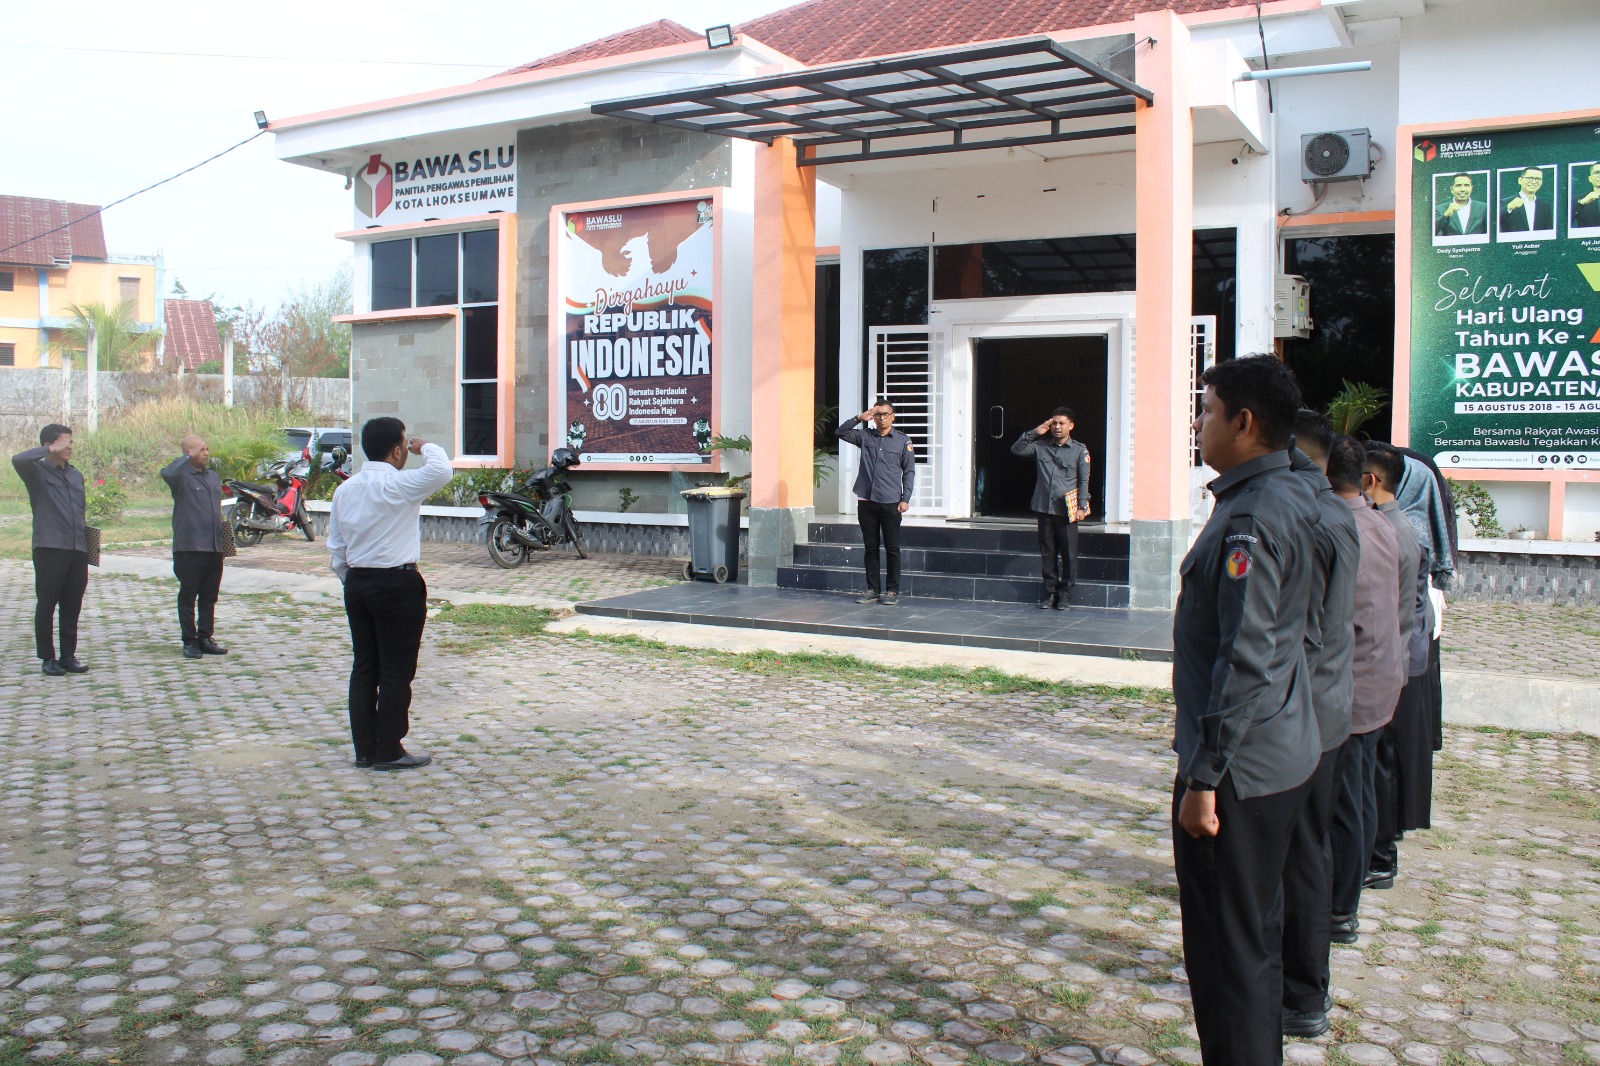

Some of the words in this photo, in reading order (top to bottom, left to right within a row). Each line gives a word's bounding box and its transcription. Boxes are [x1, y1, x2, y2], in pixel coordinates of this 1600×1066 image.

[1440, 140, 1492, 152] BAWASLU
[395, 145, 514, 182] BAWASLU
[395, 186, 425, 197] PANITIA
[426, 179, 470, 193] PENGAWAS
[470, 174, 514, 187] PEMILIHAN
[395, 198, 423, 210] KOTA
[426, 186, 514, 207] LHOKSEUMAWE
[586, 214, 622, 225] BAWASLU
[594, 277, 689, 316] Dirgahayu
[1434, 267, 1556, 312] Selamat
[584, 308, 696, 334] REPUBLIK
[1456, 307, 1504, 325] Hari
[1512, 306, 1583, 326] Ulang
[1455, 330, 1530, 347] Tahun
[1537, 328, 1568, 345] Ke
[570, 334, 710, 379] INDONESIA
[629, 388, 654, 396] Bersatu
[655, 387, 687, 395] Berdaulat
[592, 383, 627, 420] 80
[629, 398, 651, 407] Rakyat
[652, 396, 684, 406] Sejahtera
[1464, 404, 1474, 412] 15
[1477, 404, 1526, 412] AGUSTUS
[629, 407, 660, 416] Indonesia
[662, 407, 676, 416] Maju
[1474, 427, 1521, 436] Bersama
[1524, 427, 1563, 438] Rakyat
[1565, 426, 1599, 435] Awasi
[1434, 438, 1480, 446] Bersama
[1484, 437, 1530, 446] Bawaslu
[1532, 437, 1588, 448] Tegakkan
